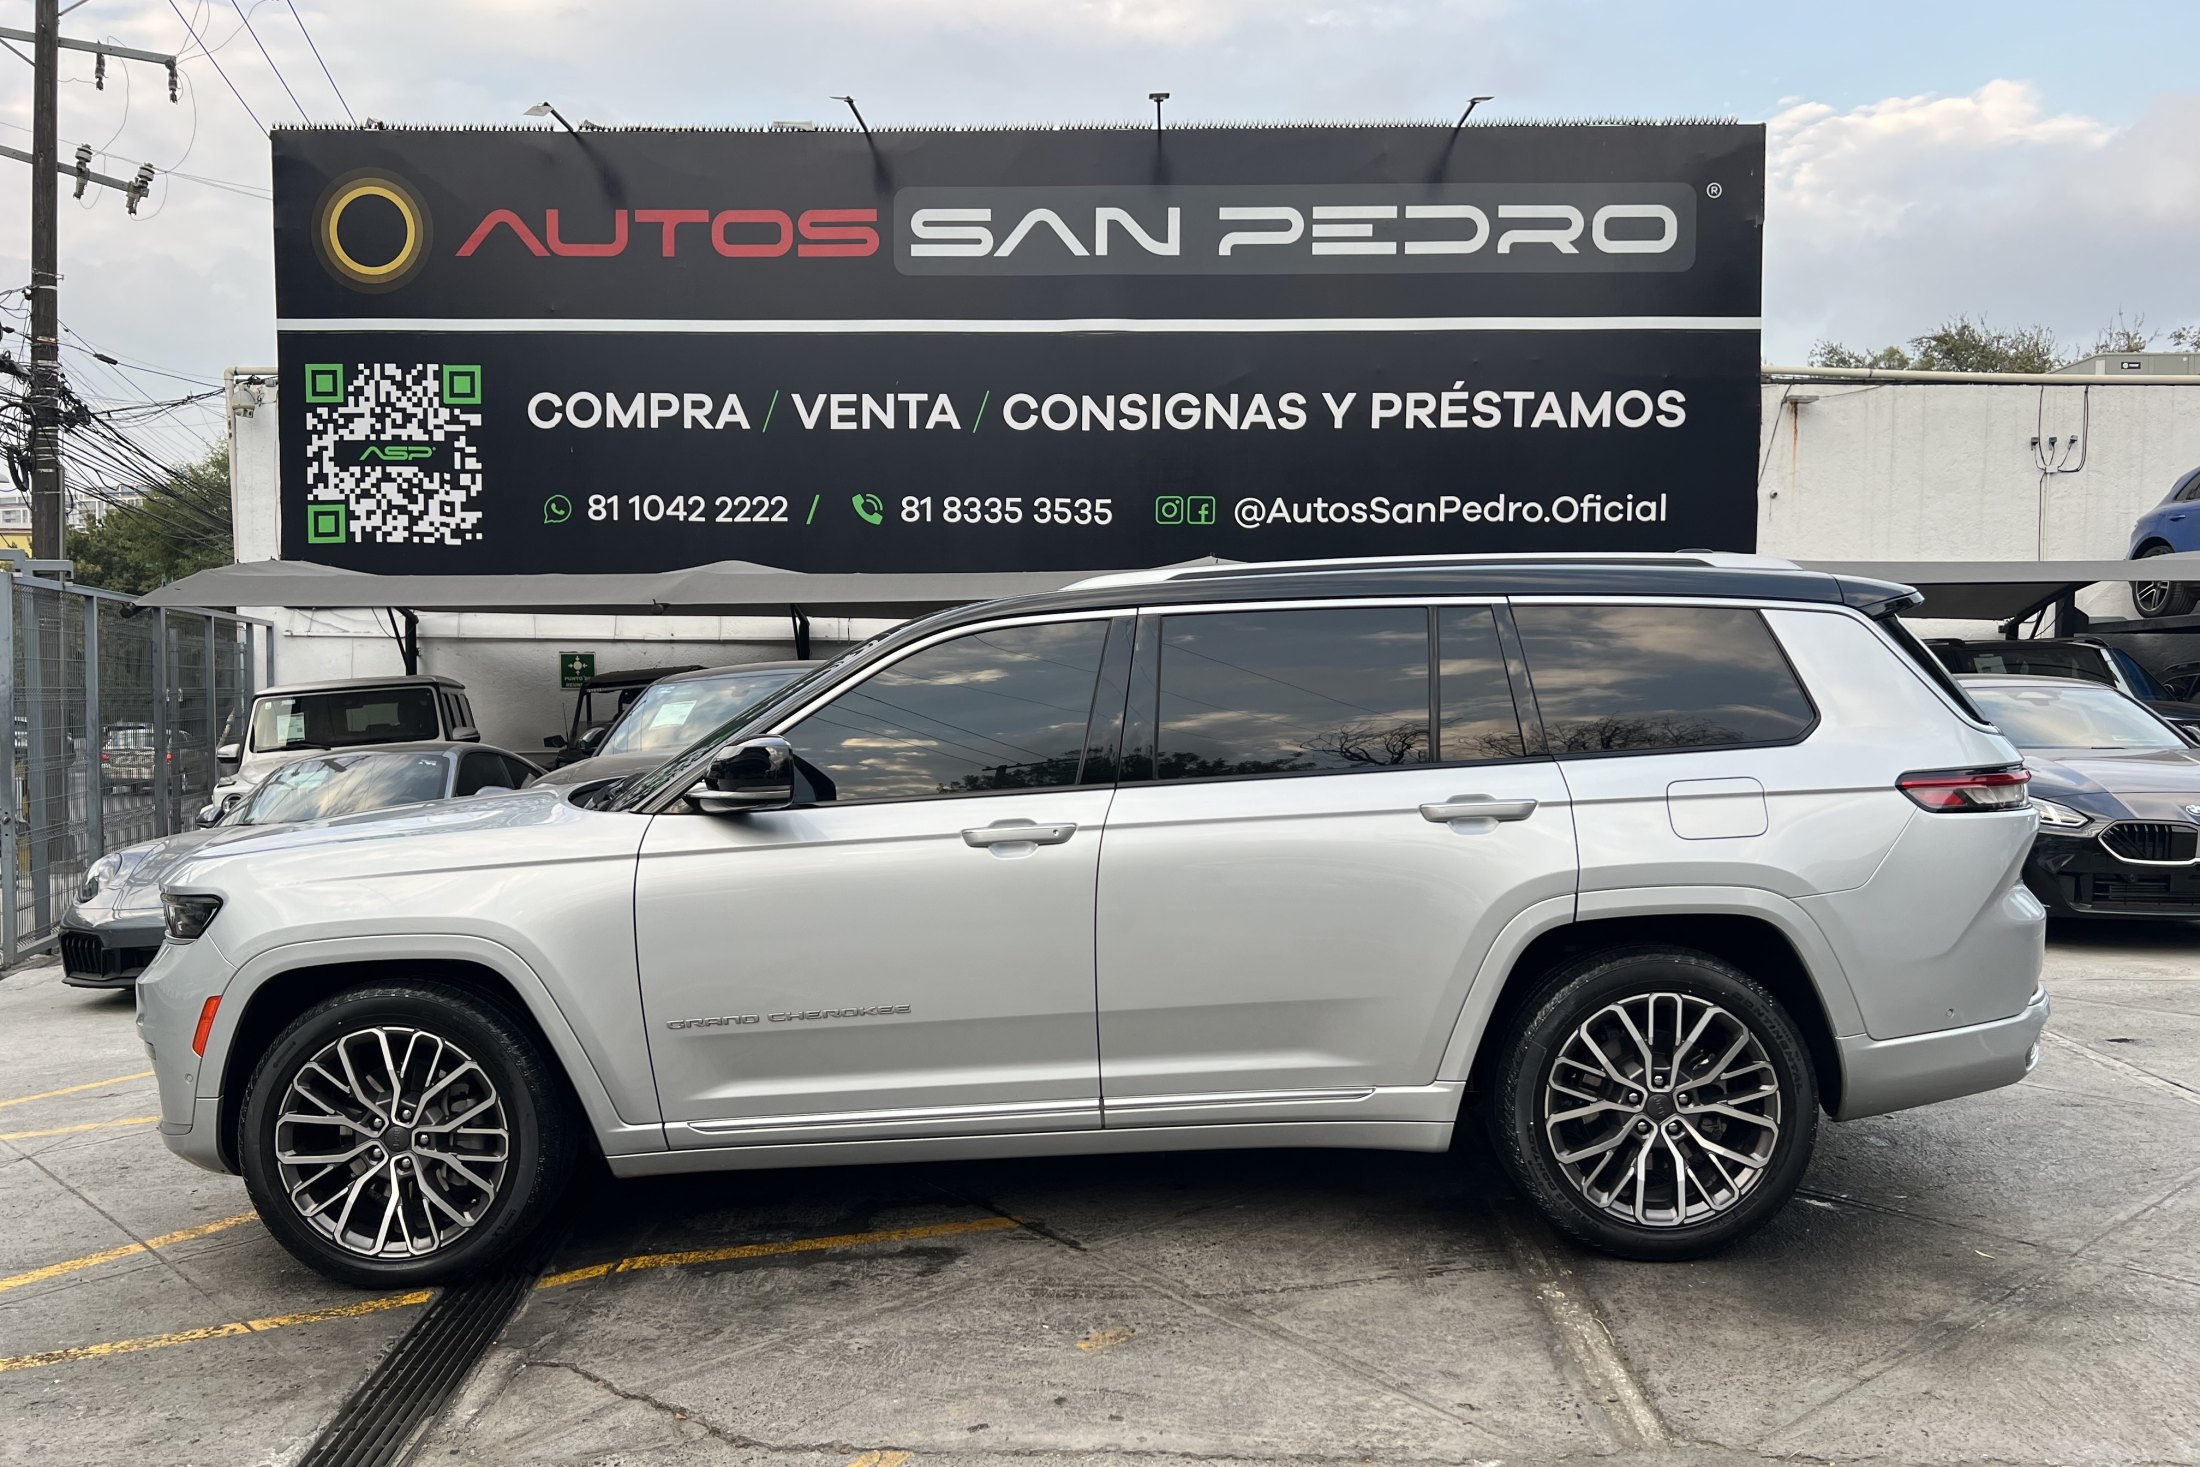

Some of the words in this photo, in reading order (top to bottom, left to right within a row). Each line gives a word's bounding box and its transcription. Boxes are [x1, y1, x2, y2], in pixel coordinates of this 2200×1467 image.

[456, 208, 880, 257] AUTOS
[911, 206, 1181, 257] SAN
[1219, 204, 1678, 256] PEDRO
[527, 391, 751, 430] COMPRA
[791, 393, 962, 430] VENTA
[1003, 392, 1307, 431] CONSIGNAS
[1322, 392, 1355, 429] Y
[1371, 380, 1686, 429] PRÉSTAMOS
[360, 446, 433, 461] ASP
[587, 494, 619, 522] 81
[628, 494, 706, 522] 1042
[714, 495, 789, 523] 2222
[900, 495, 932, 523] 81
[942, 496, 1023, 524] 8335
[1033, 496, 1113, 525] 3535
[1234, 493, 1667, 529] @AutosSanPedro.Oficial
[666, 1014, 760, 1030] GRAND
[767, 1003, 912, 1023] CHEROKEE
